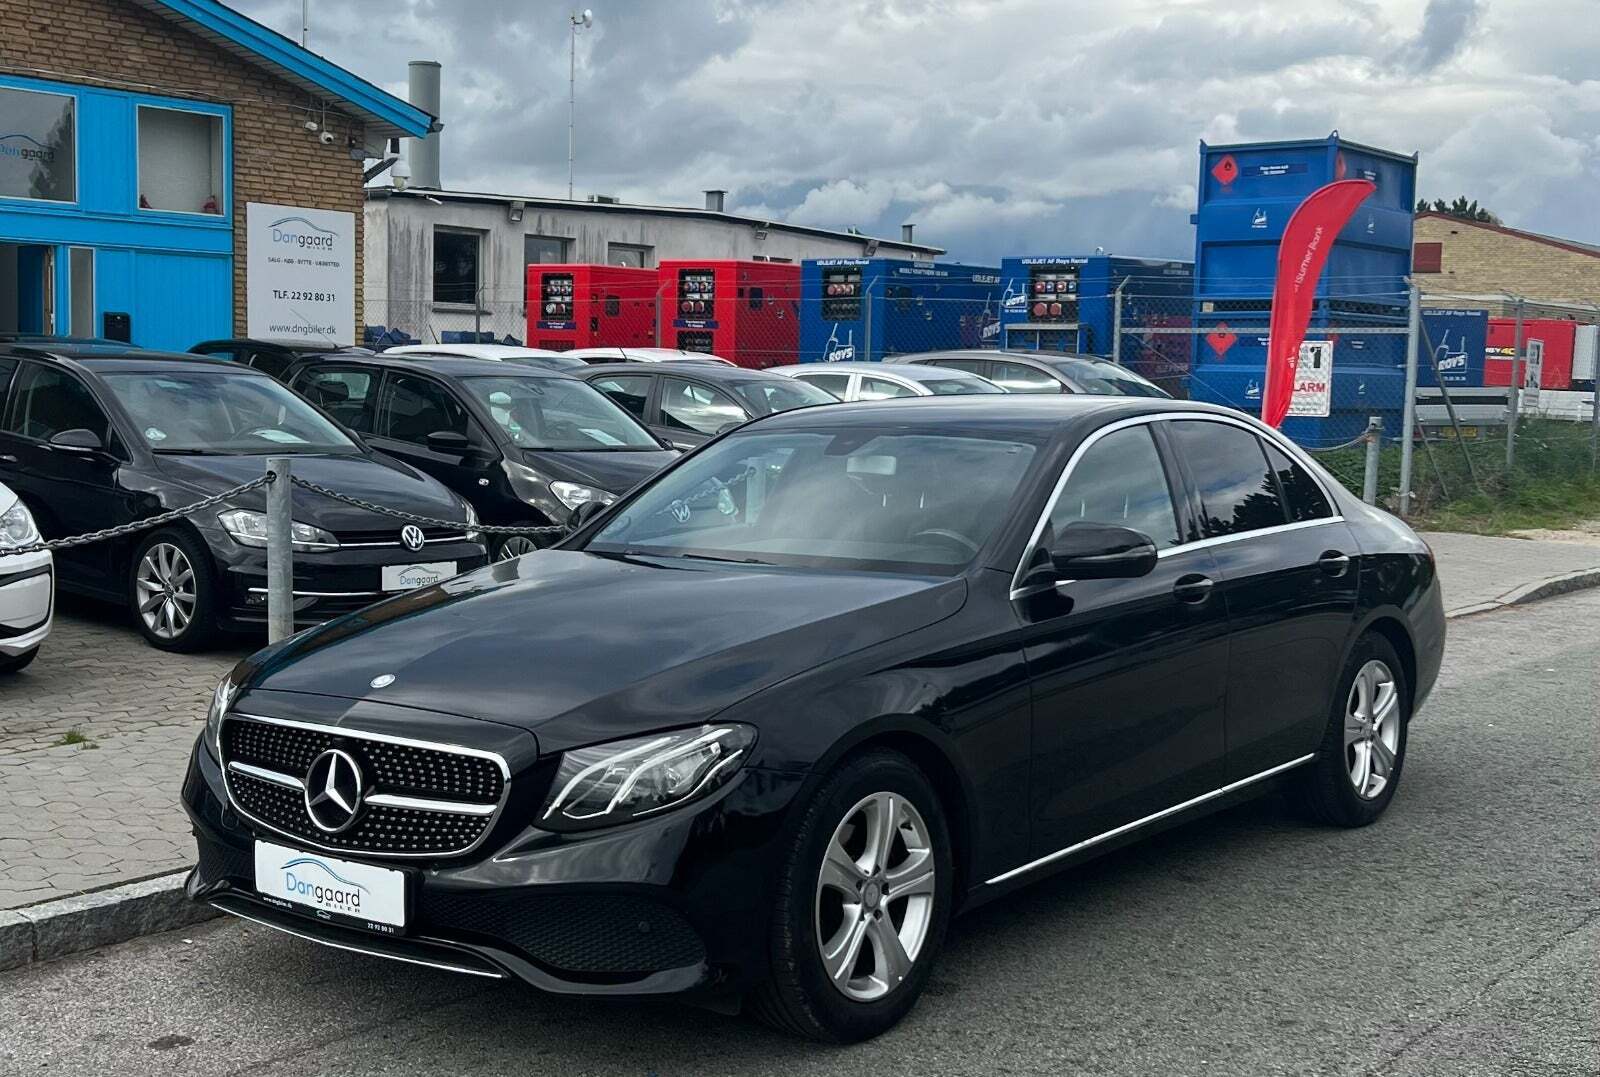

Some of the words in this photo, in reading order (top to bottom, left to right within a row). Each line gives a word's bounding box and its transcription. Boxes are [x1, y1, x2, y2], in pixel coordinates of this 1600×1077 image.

[273, 229, 333, 248] Dangaard
[1308, 226, 1323, 250] Bank
[273, 289, 290, 300] TLF.
[291, 291, 301, 300] 22
[303, 292, 313, 301] 92
[314, 292, 325, 302] 80
[326, 293, 336, 302] 31
[269, 323, 337, 336] www.dngbiler.dk
[828, 348, 854, 363] ROYS
[1438, 354, 1466, 371] ROYS
[1293, 382, 1325, 393] LARM
[400, 575, 439, 586] Dangaard
[286, 872, 361, 908] Dangaard
